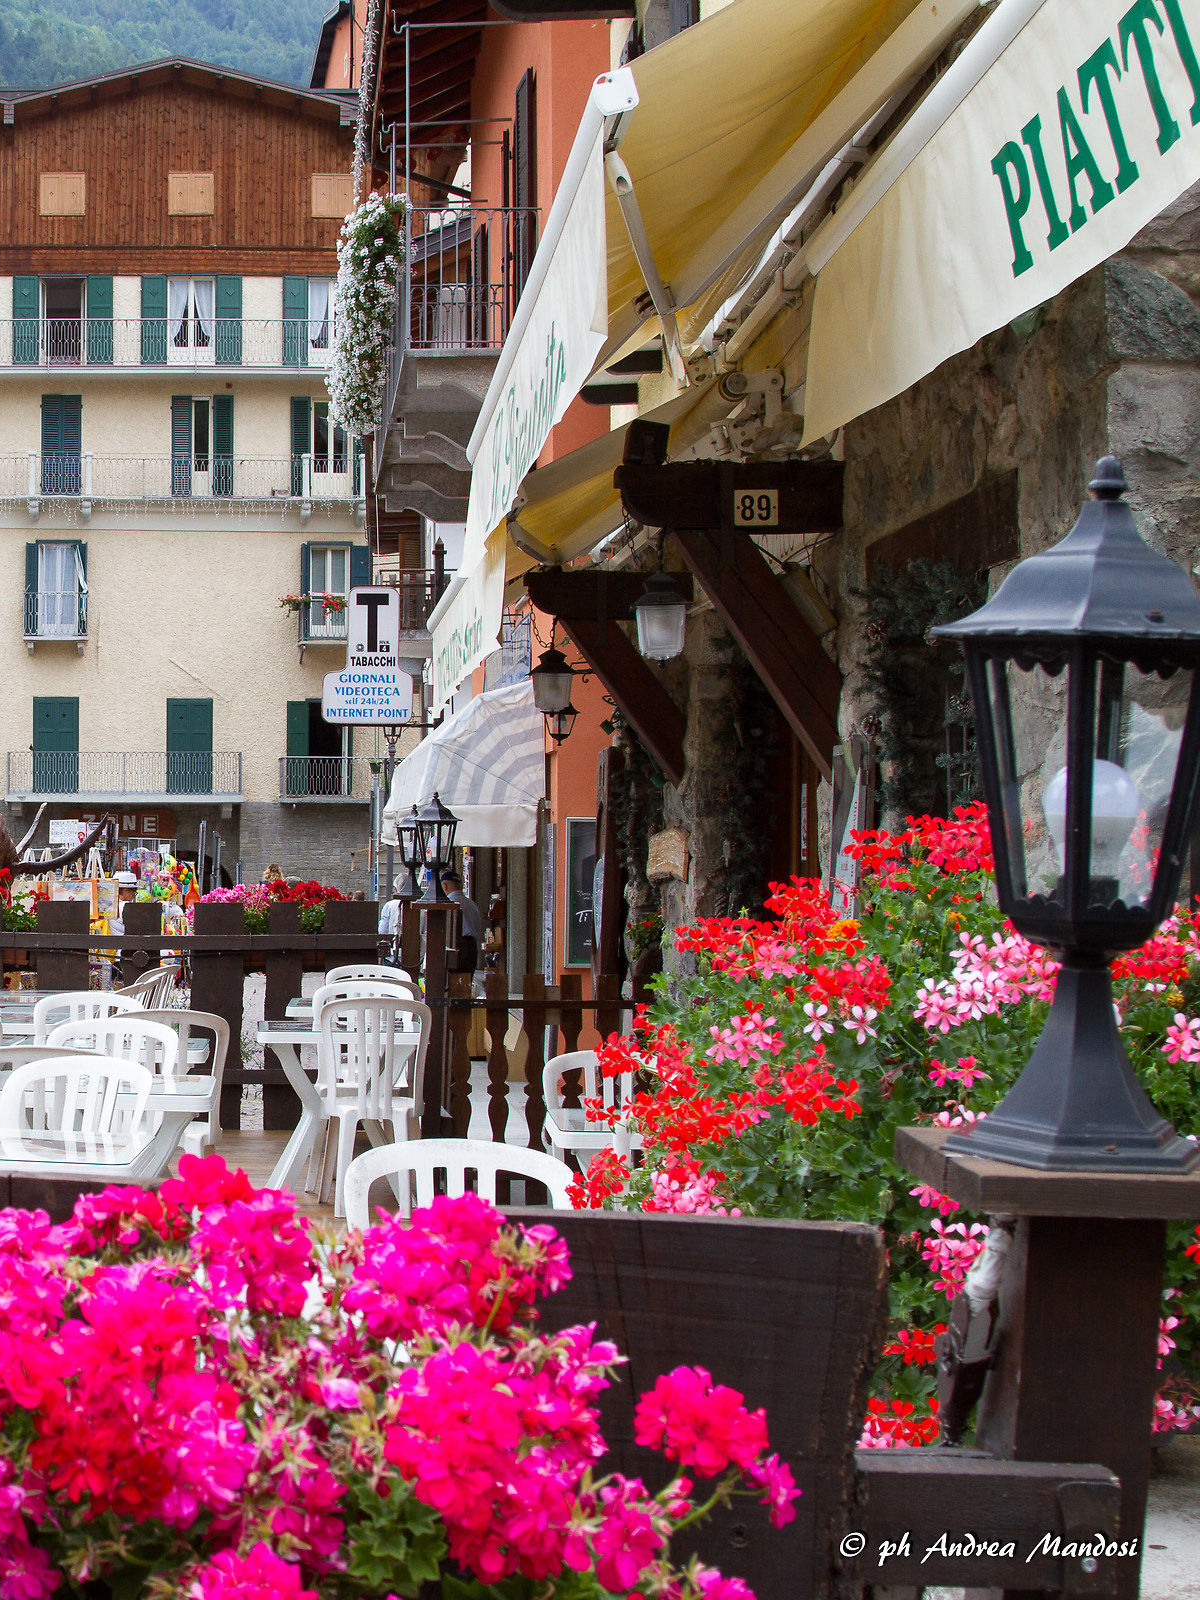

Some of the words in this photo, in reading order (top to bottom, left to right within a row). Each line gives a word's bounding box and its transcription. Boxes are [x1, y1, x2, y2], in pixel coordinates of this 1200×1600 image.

[740, 494, 771, 521] 89
[356, 593, 390, 652] T
[350, 656, 396, 667] TABACCHI
[339, 673, 396, 684] GIORNALI
[334, 686, 400, 696] VIDEOTECA
[326, 708, 373, 718] INTERNET
[377, 708, 408, 718] POINT
